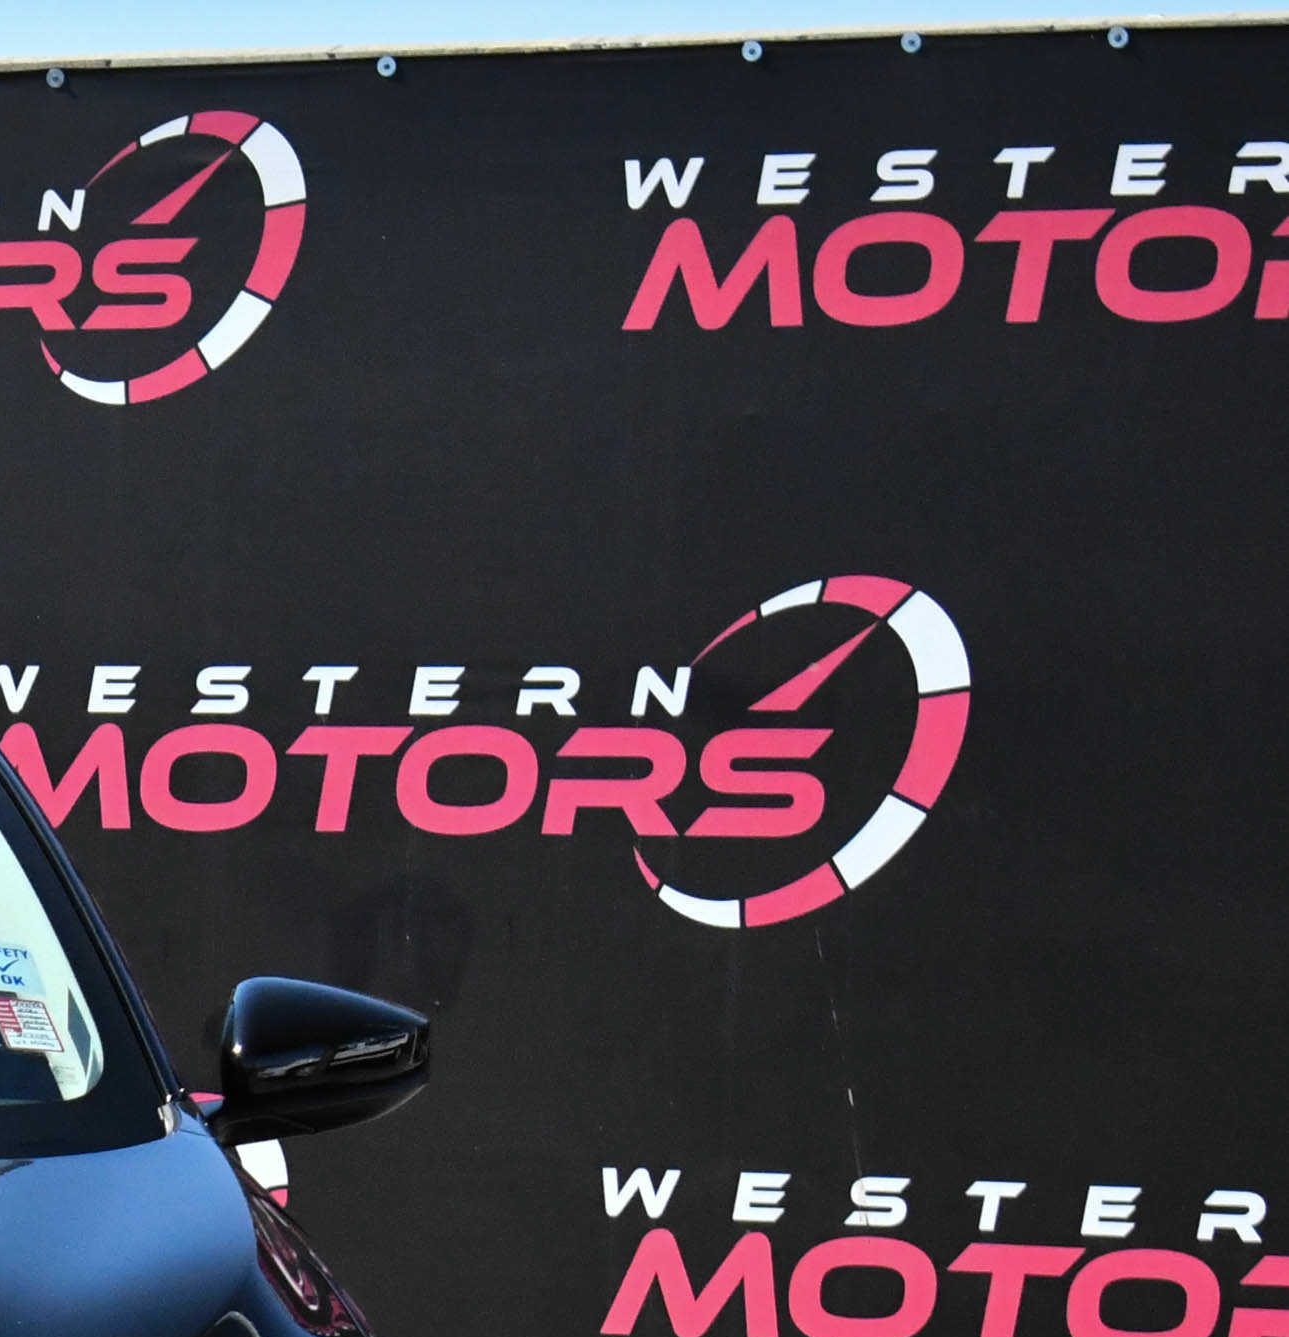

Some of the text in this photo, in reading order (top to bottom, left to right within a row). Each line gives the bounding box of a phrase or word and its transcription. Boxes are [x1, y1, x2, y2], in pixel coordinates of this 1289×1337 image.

[623, 205, 1289, 330] MOTO
[0, 974, 26, 986] OK
[602, 1168, 1266, 1243] WESTER
